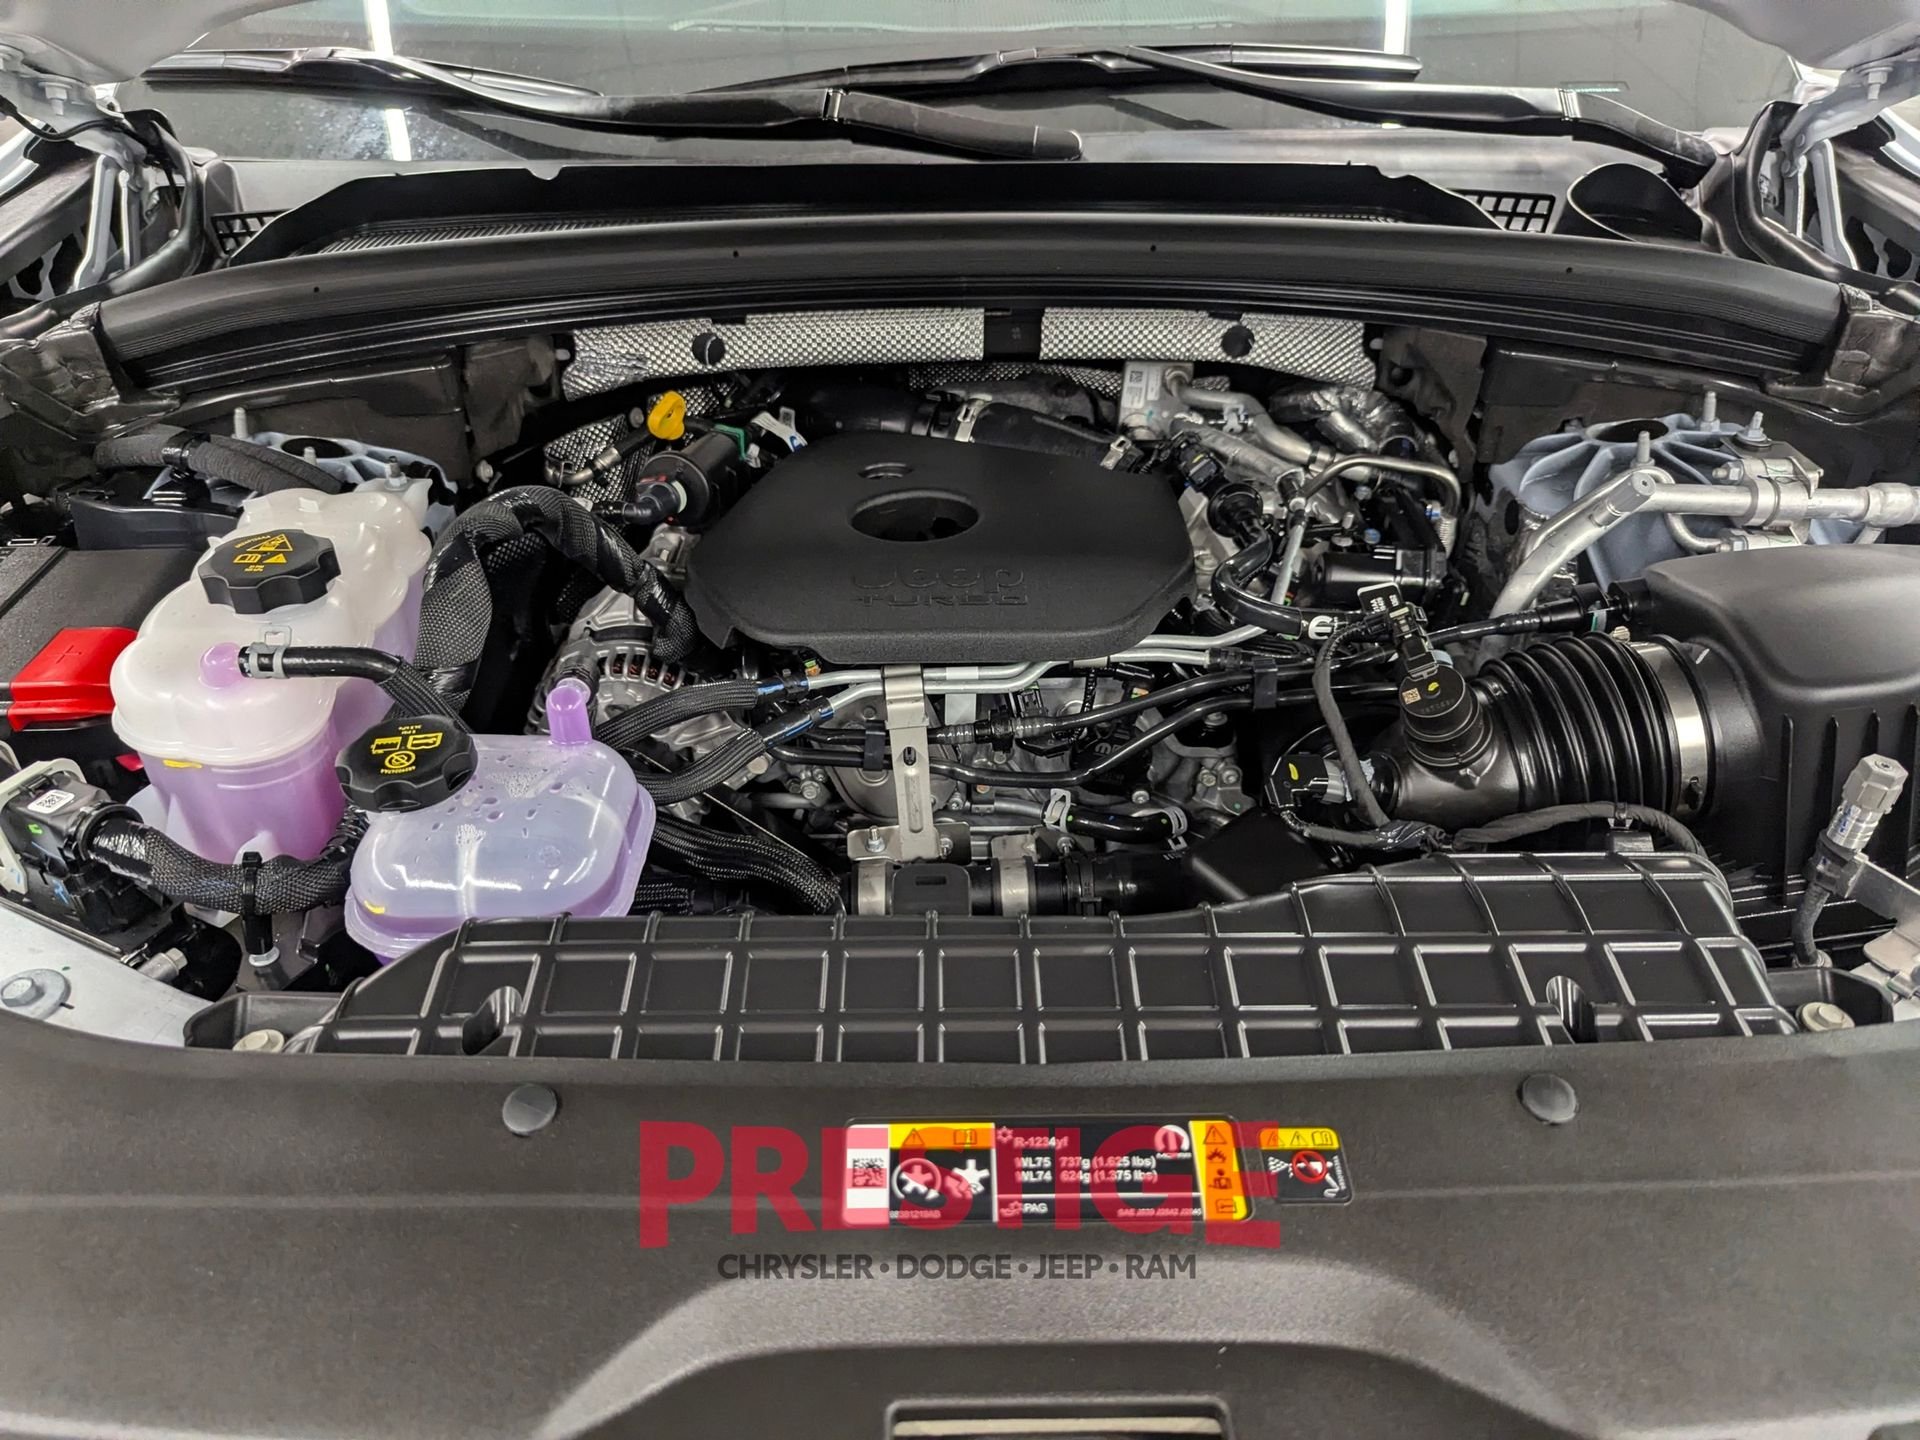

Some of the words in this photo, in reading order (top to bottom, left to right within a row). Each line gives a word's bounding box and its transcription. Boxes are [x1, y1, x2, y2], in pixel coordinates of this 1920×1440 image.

[852, 566, 1024, 593] Jeep
[852, 592, 1029, 606] TURBO
[1013, 1135, 1068, 1150] R-1234yf
[1014, 1156, 1051, 1168] WL75
[1059, 1156, 1090, 1170] 737g
[1092, 1155, 1130, 1169] (1.625
[1131, 1155, 1156, 1169] lbs)
[1014, 1169, 1053, 1182] WL74
[1060, 1169, 1092, 1184] 624g
[1093, 1169, 1131, 1183] (1.375
[1132, 1168, 1158, 1182] lbs)
[1022, 1202, 1048, 1214] PAG
